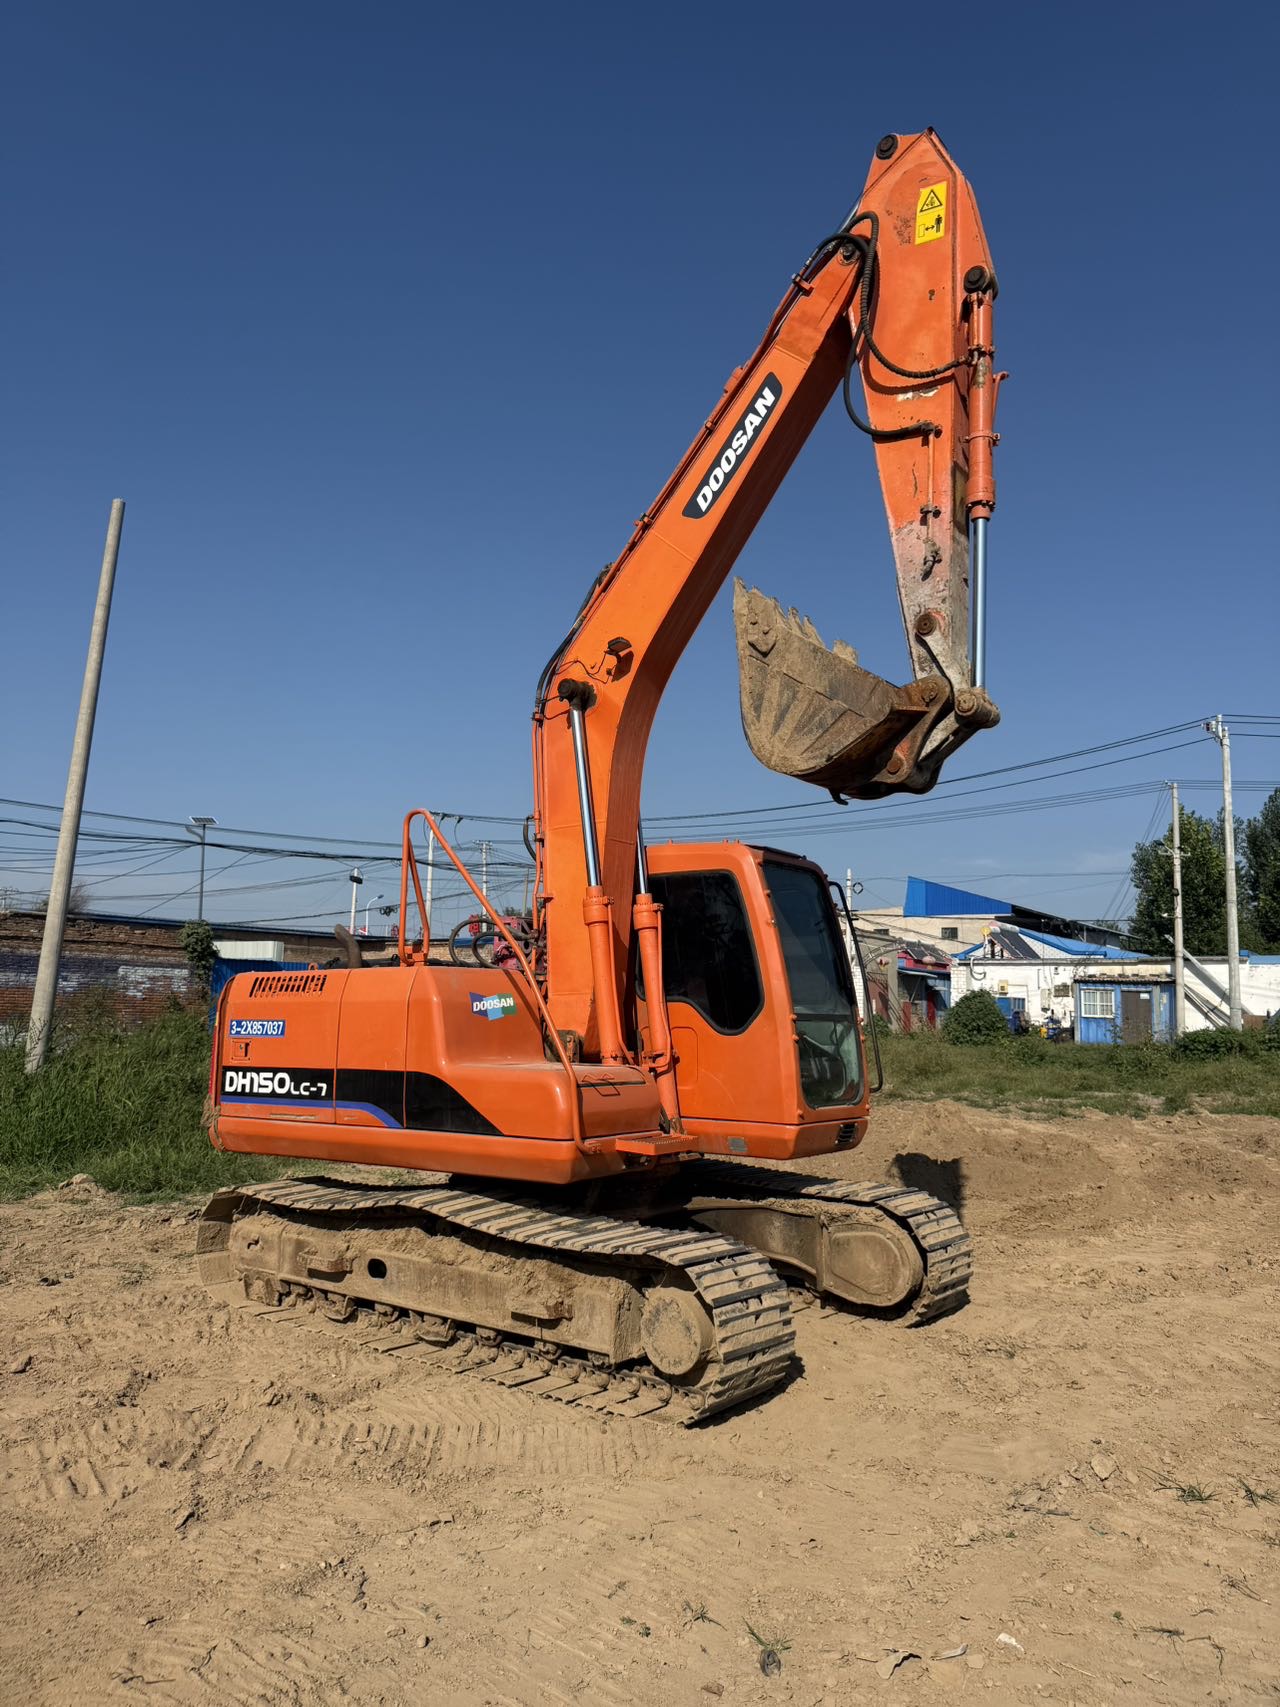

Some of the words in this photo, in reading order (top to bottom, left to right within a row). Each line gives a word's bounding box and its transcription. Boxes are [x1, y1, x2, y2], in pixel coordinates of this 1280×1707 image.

[696, 386, 776, 512] DOOSAN
[473, 997, 514, 1012] DOOSAN
[231, 1020, 284, 1035] 3-2X857037
